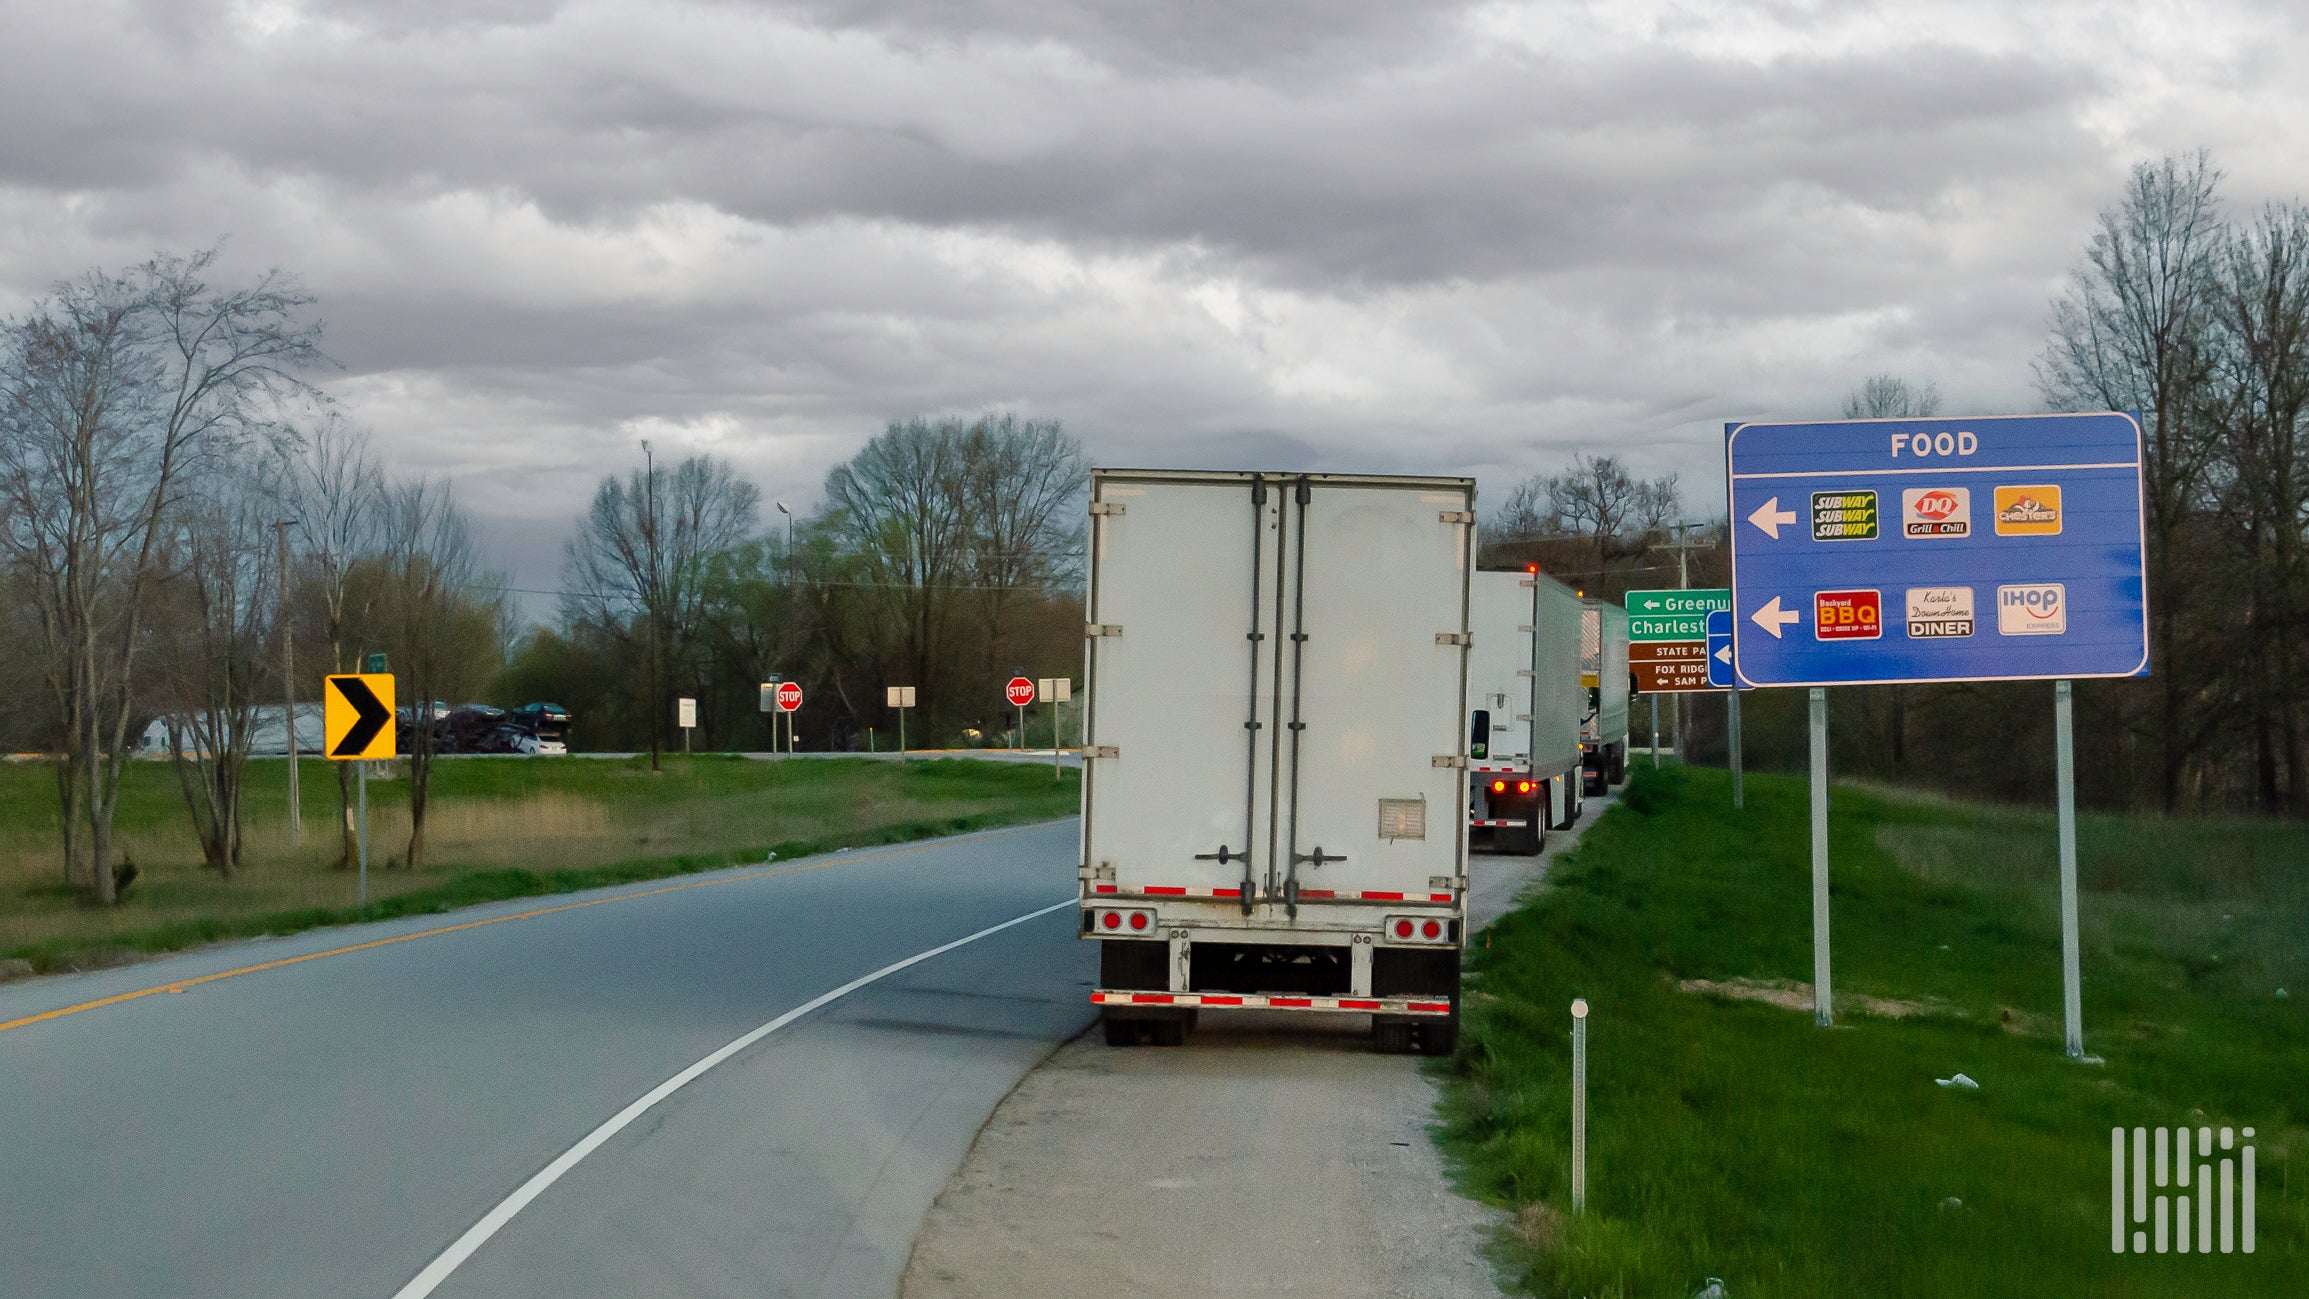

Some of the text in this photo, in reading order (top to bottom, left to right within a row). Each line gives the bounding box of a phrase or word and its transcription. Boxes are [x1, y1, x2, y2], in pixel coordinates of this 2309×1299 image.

[1891, 432, 1978, 457] FOOD
[1814, 494, 1874, 509] SUBWAY
[1921, 497, 1953, 514] DQ
[1815, 508, 1875, 523] SUBWAY
[1816, 522, 1875, 536] SUBWAY
[1910, 523, 1965, 534] Grill Chill
[1820, 605, 1876, 625] BBQ
[1911, 621, 1970, 636] DINER
[1656, 647, 1688, 656] STATE
[1655, 665, 1675, 674] FOX
[1674, 677, 1697, 686] SAM
[780, 691, 801, 702] STOP
[1009, 686, 1032, 697] STOP
